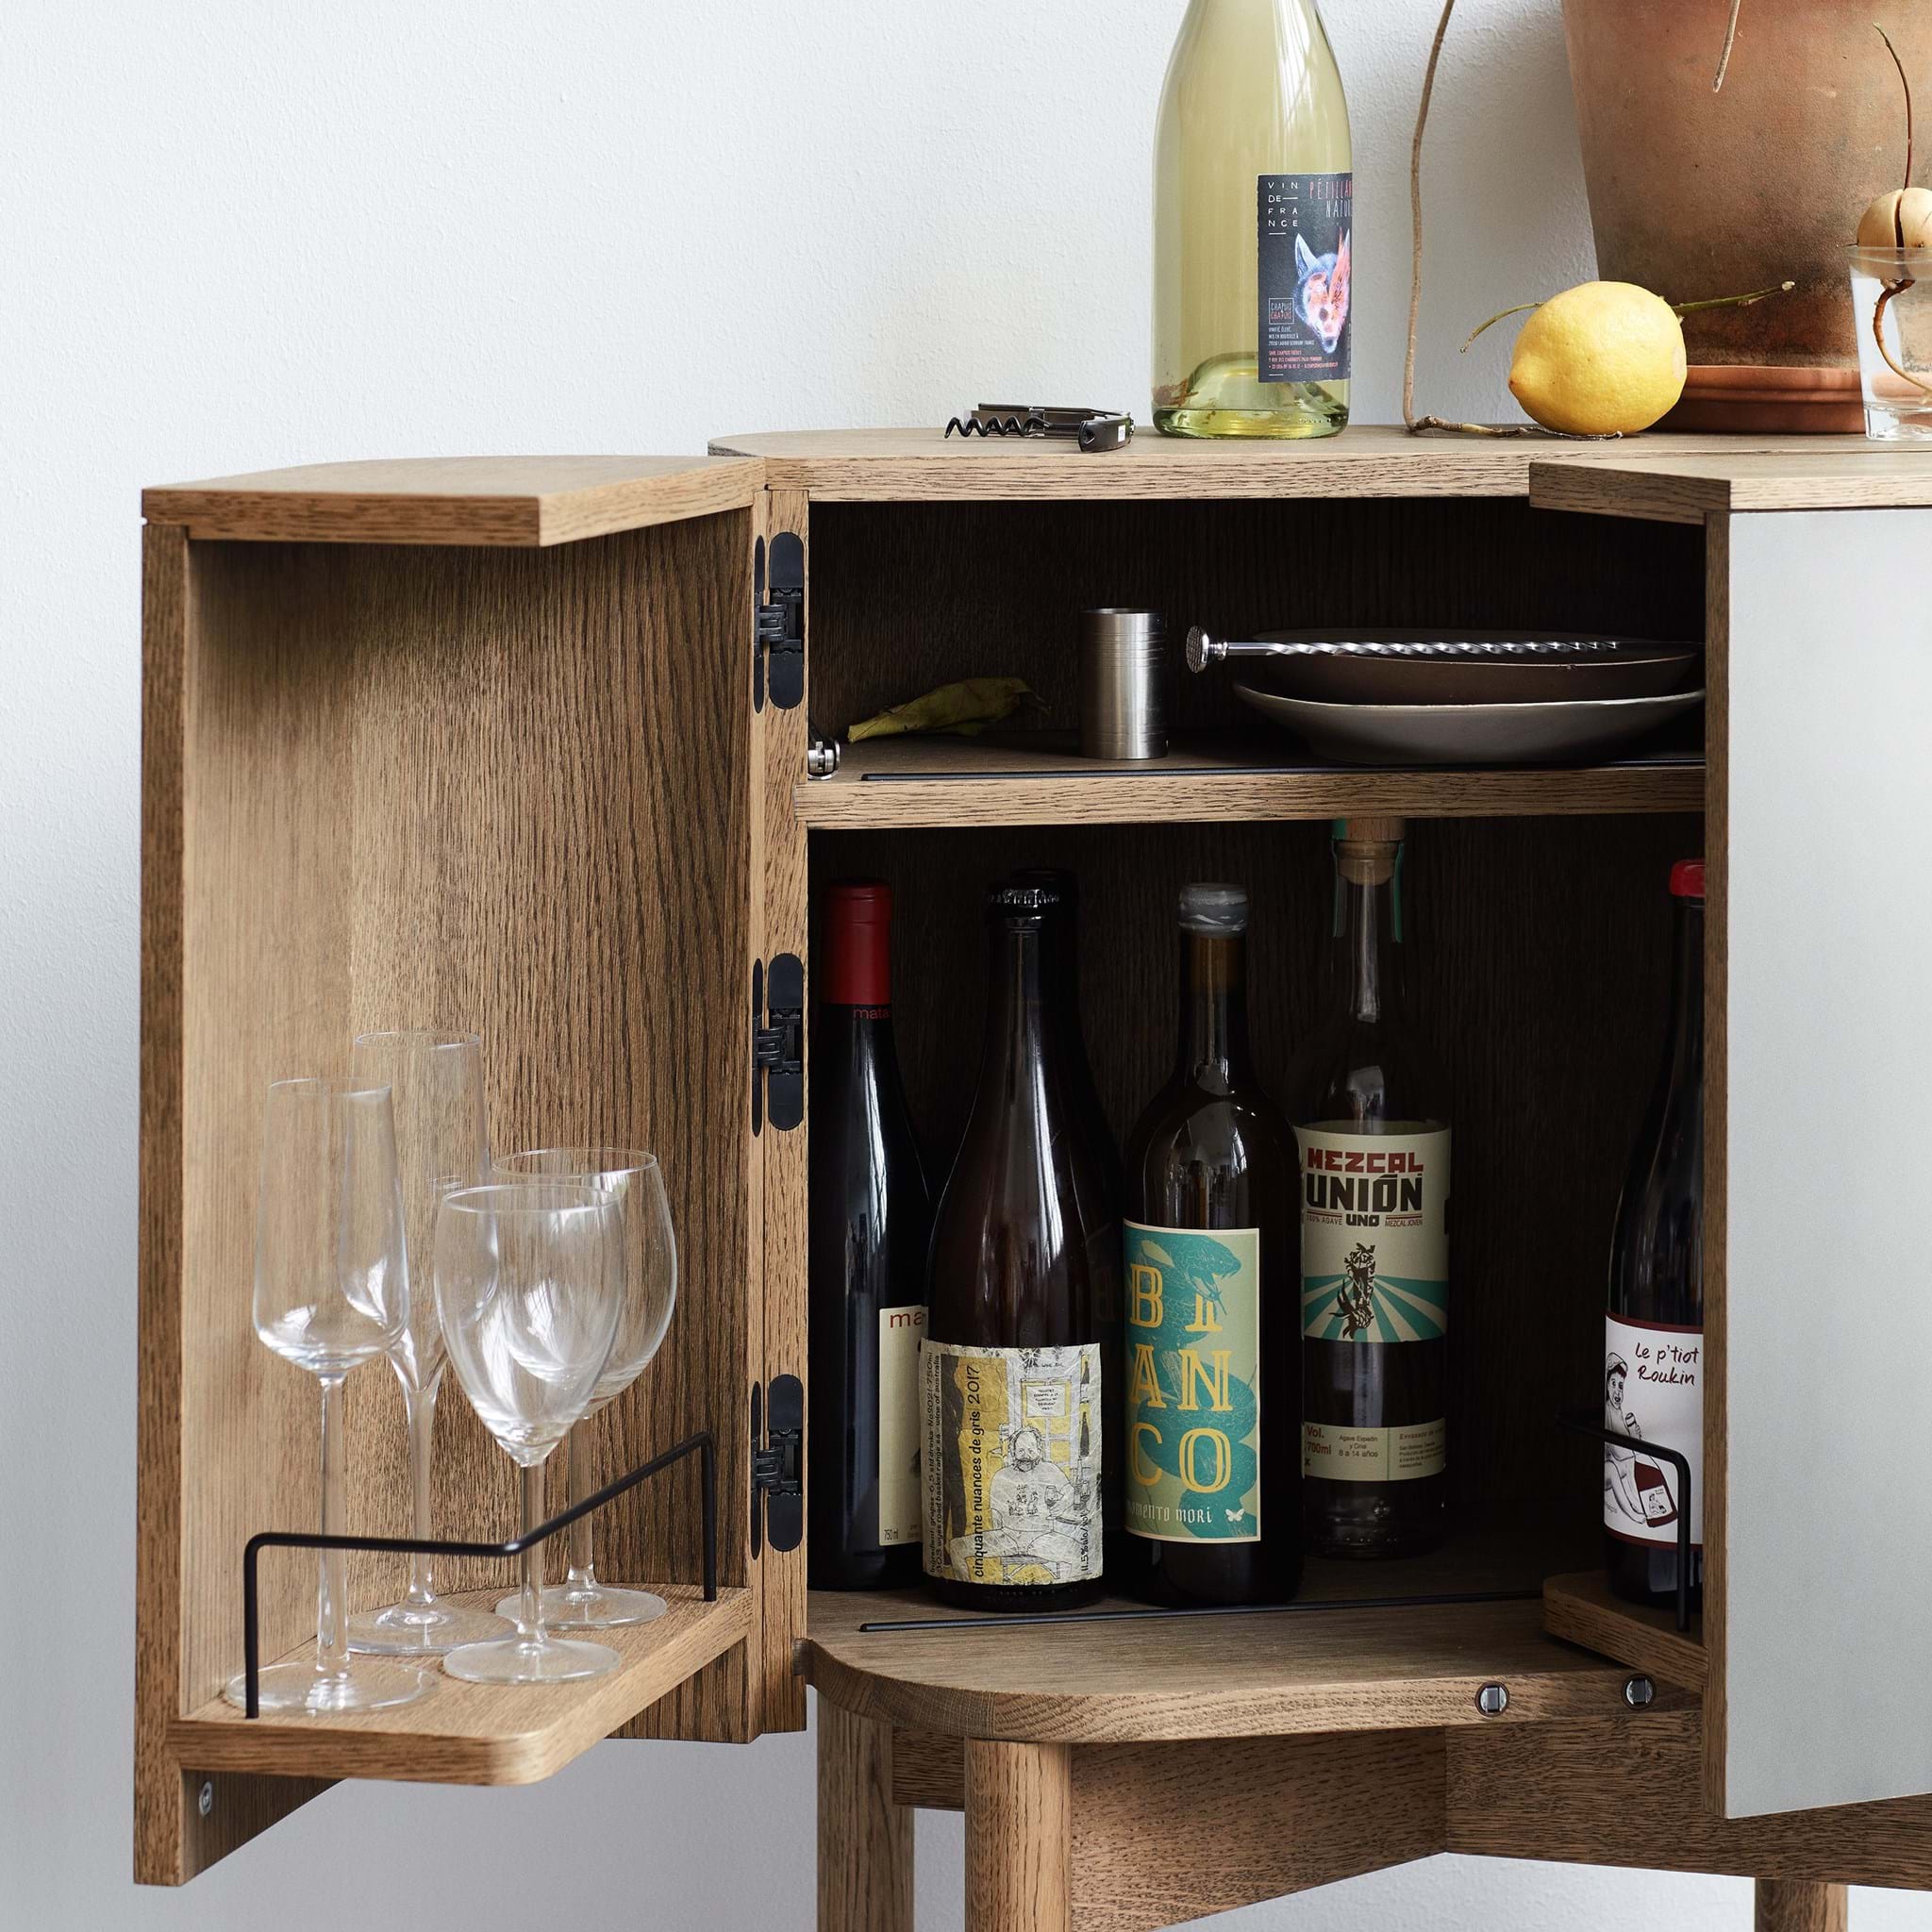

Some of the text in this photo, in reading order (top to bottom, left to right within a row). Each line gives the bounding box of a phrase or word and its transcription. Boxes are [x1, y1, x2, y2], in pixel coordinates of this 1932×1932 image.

[853, 1007, 891, 1019] mata
[1307, 1147, 1424, 1173] MEZCAL
[1307, 1174, 1423, 1212] UNIÓN
[1321, 1216, 1342, 1225] AGAVE
[1346, 1214, 1379, 1226] UNO
[1657, 1345, 1700, 1365] p'tiot
[1637, 1365, 1695, 1386] Roukin
[1306, 1425, 1325, 1439] Vol.
[967, 1365, 987, 1577] cinquante nuances de gris 2017
